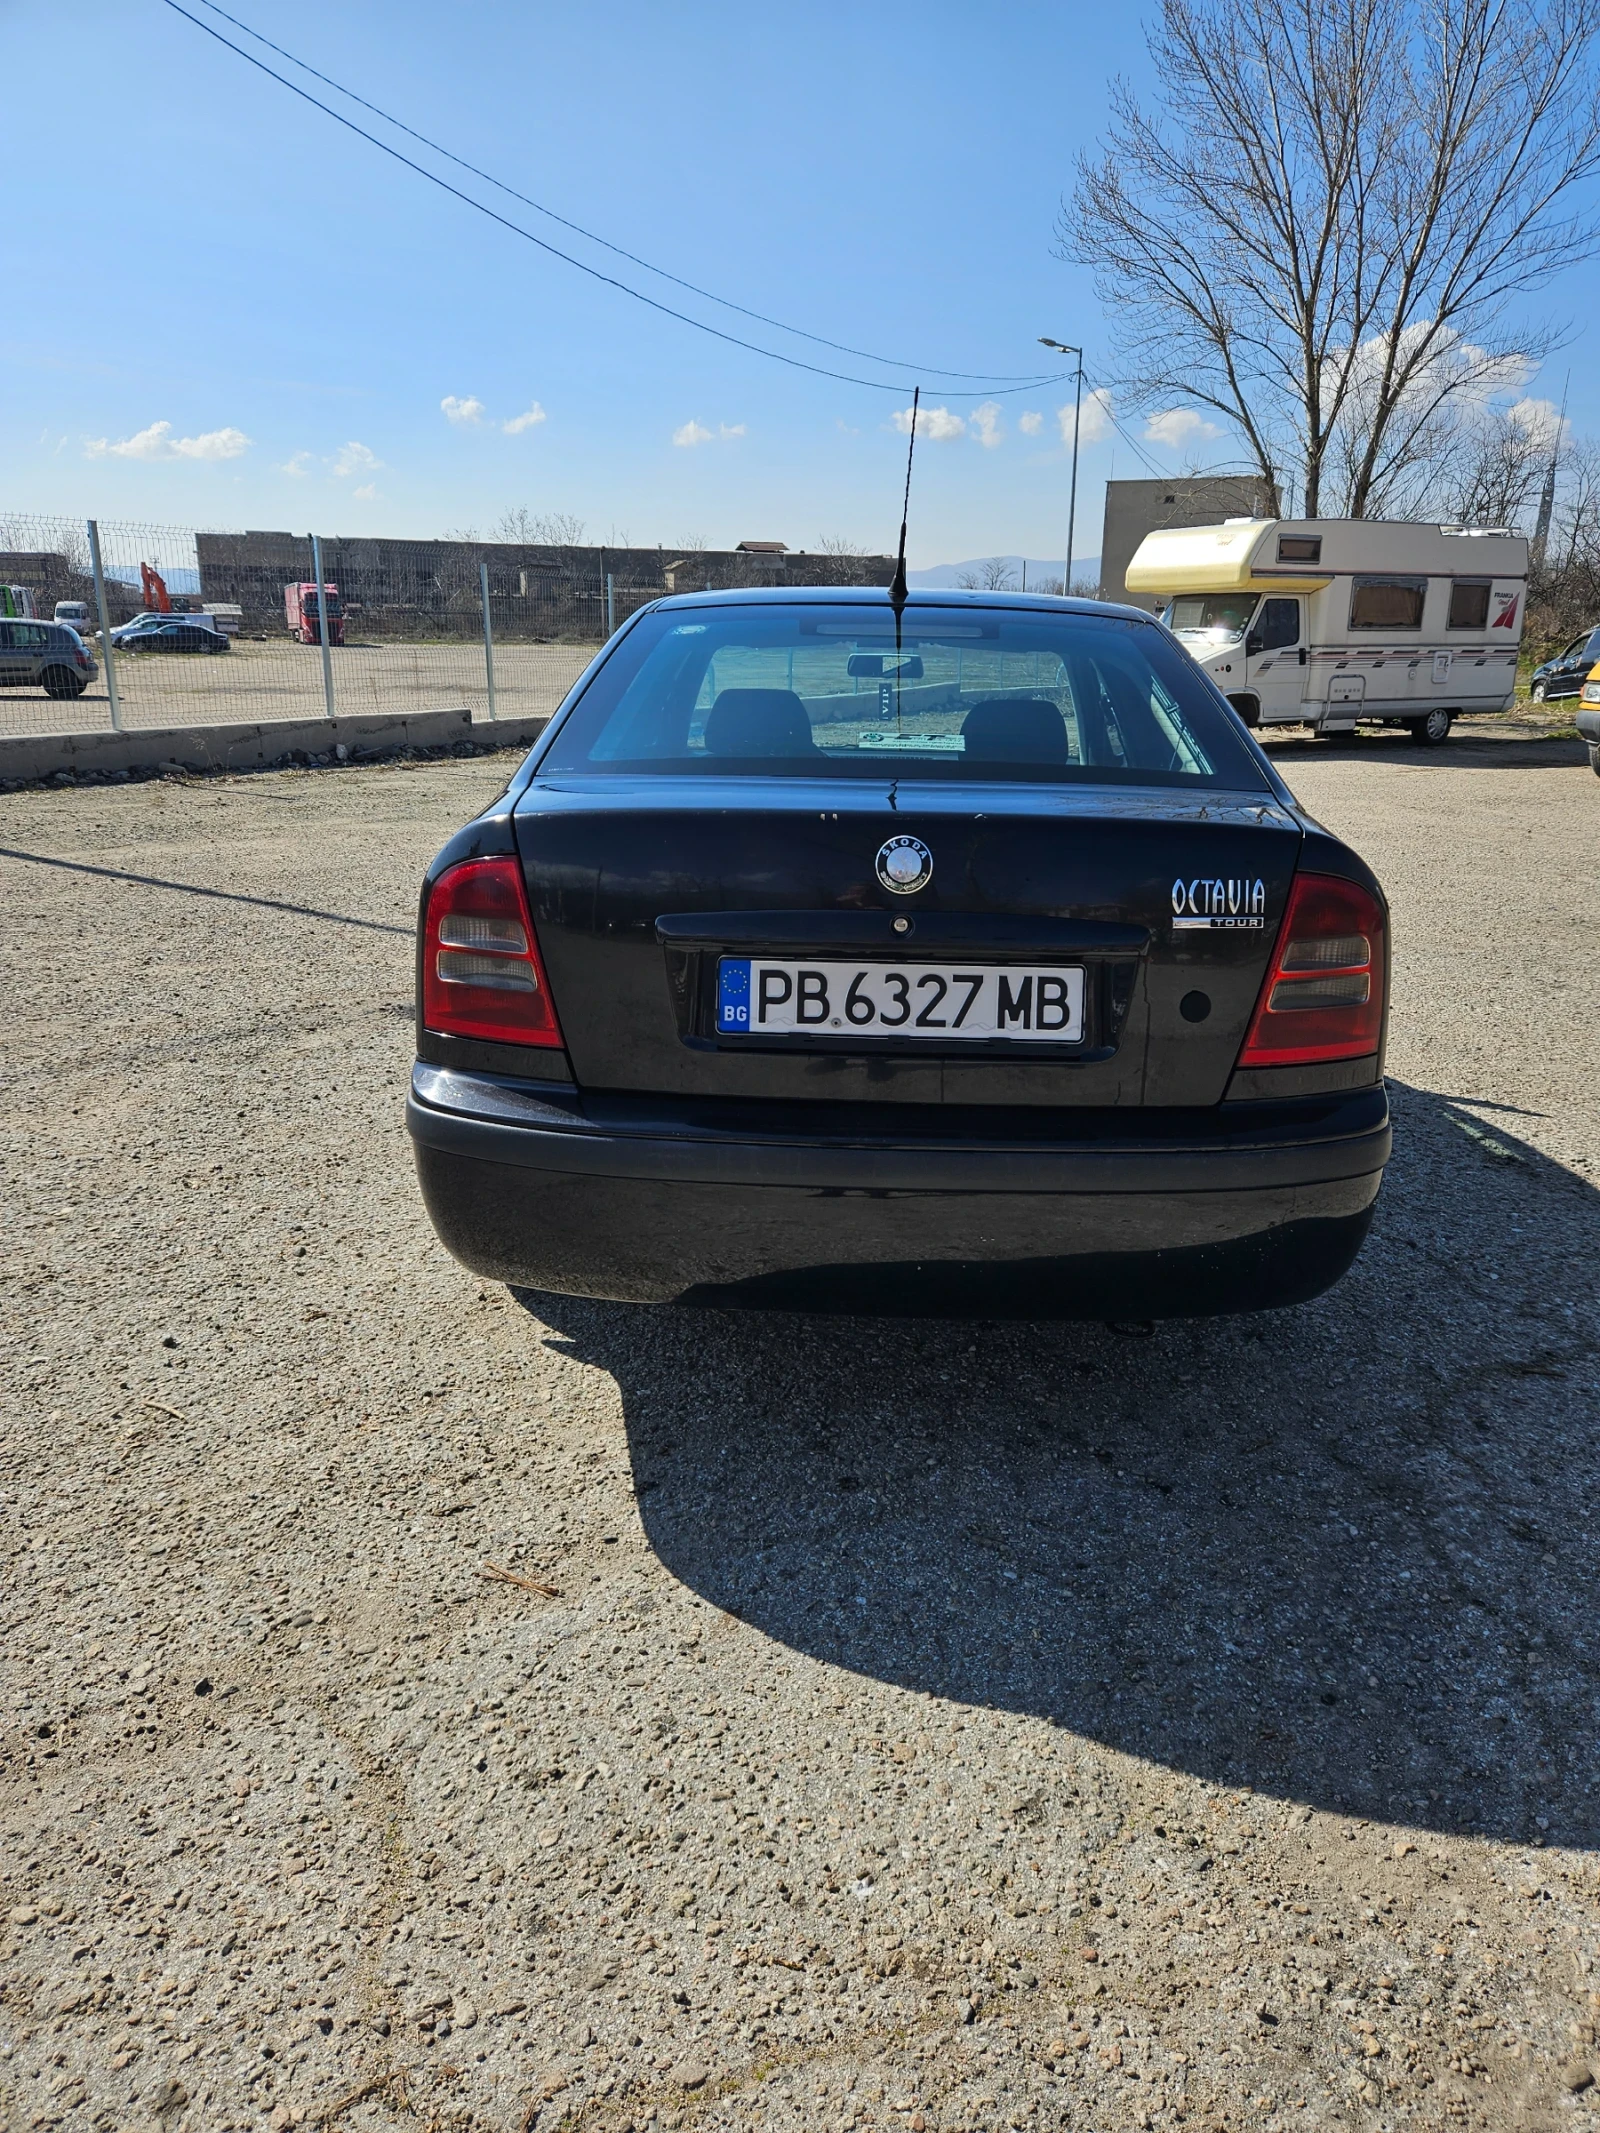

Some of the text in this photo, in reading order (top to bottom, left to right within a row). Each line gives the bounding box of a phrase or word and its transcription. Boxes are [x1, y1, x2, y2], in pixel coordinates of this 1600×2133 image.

[1171, 878, 1265, 915] OCTAVIA
[1215, 919, 1259, 927] TOUR
[757, 969, 1071, 1031] PB 6327 MB
[723, 1006, 748, 1022] BG
